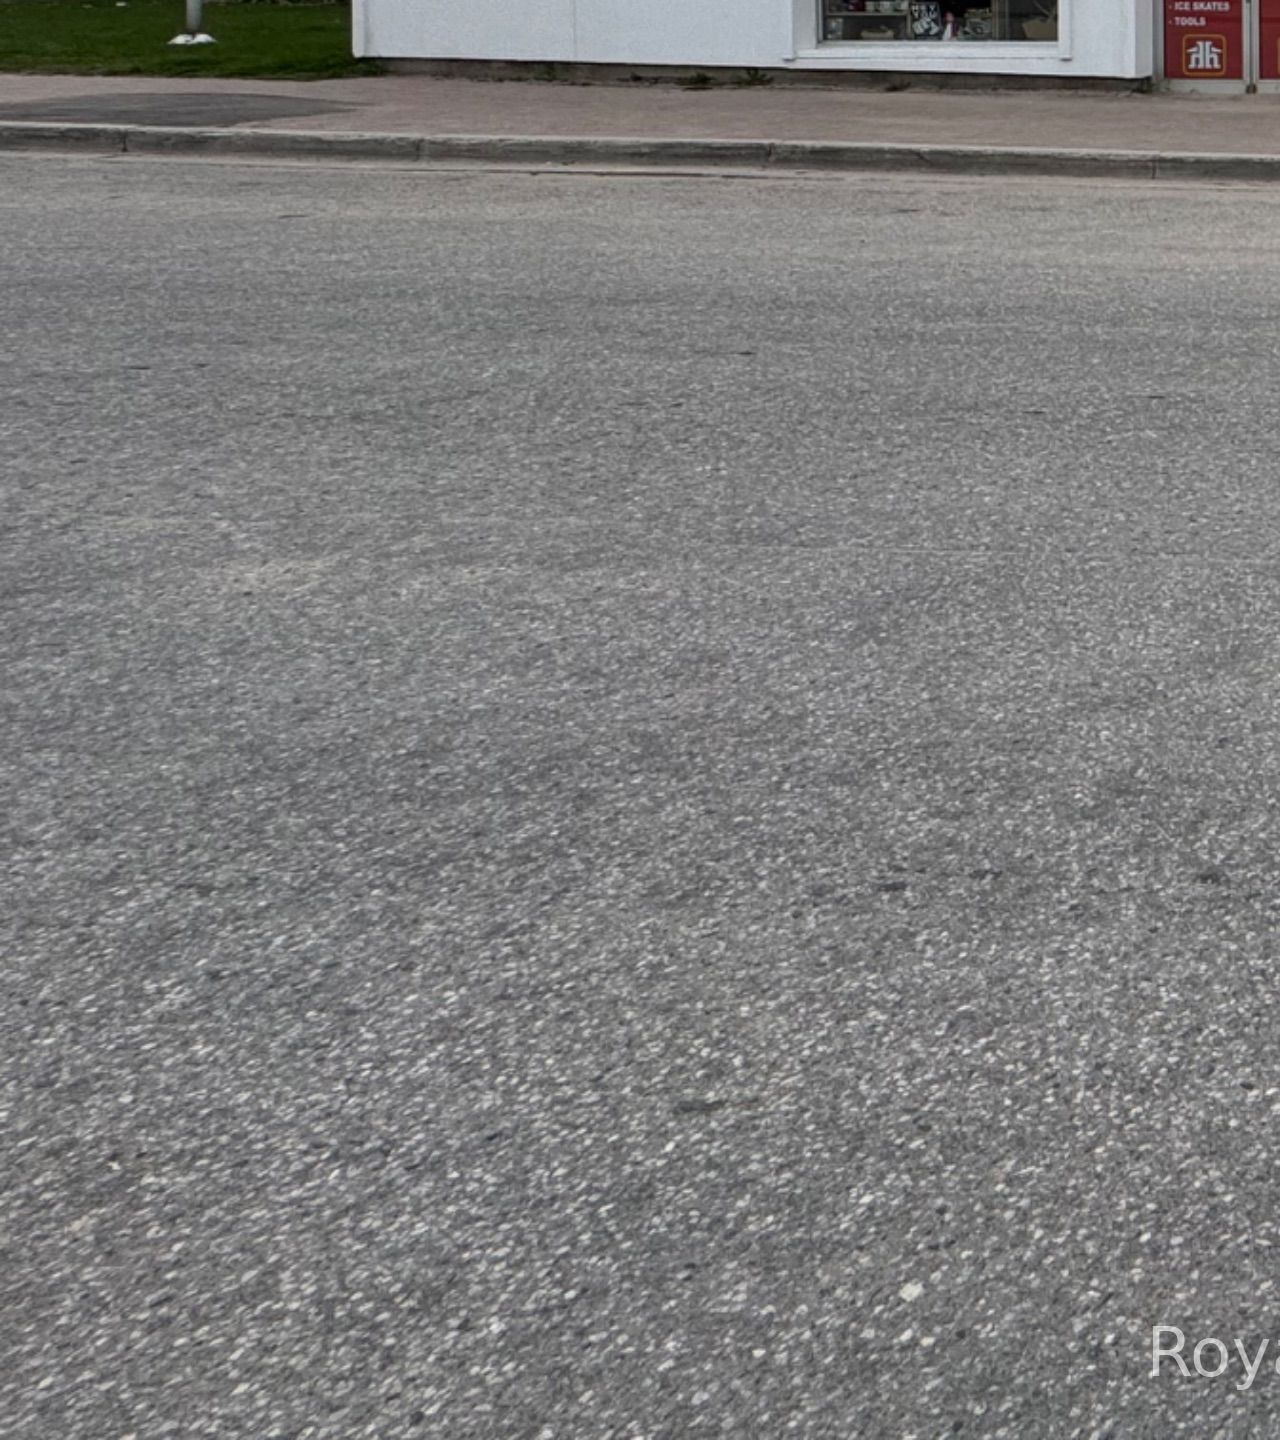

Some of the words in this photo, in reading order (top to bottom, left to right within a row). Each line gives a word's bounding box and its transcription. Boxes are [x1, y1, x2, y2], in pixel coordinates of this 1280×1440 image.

[1174, 1, 1190, 11] ICE
[1192, 1, 1230, 11] SKATES
[1174, 16, 1206, 26] TOOLS
